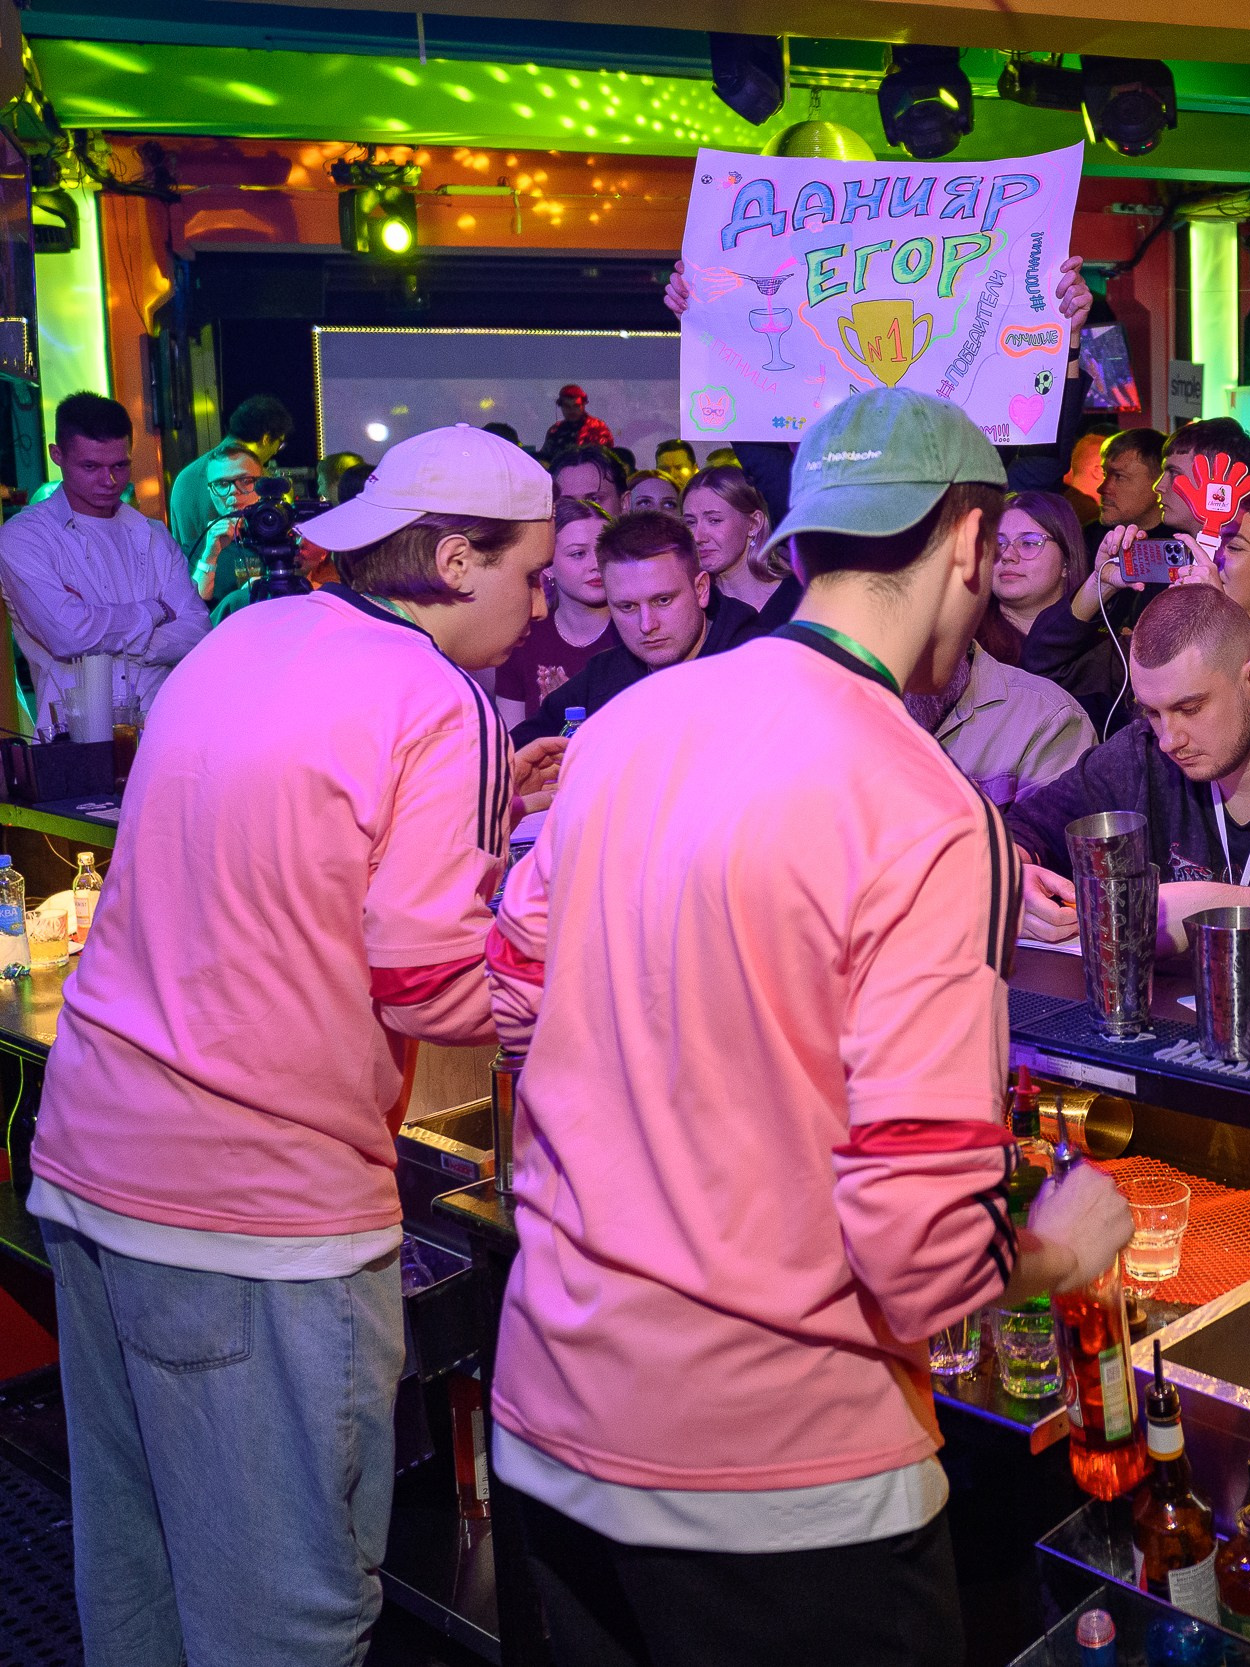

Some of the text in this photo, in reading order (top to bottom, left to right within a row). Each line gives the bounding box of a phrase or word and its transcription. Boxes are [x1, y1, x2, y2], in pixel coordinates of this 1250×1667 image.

[720, 172, 1042, 251] ДАНИЯР
[805, 232, 993, 308] ЕГОР
[700, 331, 778, 395] #ПЯТНИЦА
[936, 269, 1008, 400] #ПОБЕДИТЕЛИ
[1005, 329, 1059, 347] ЛУЧШИЕ
